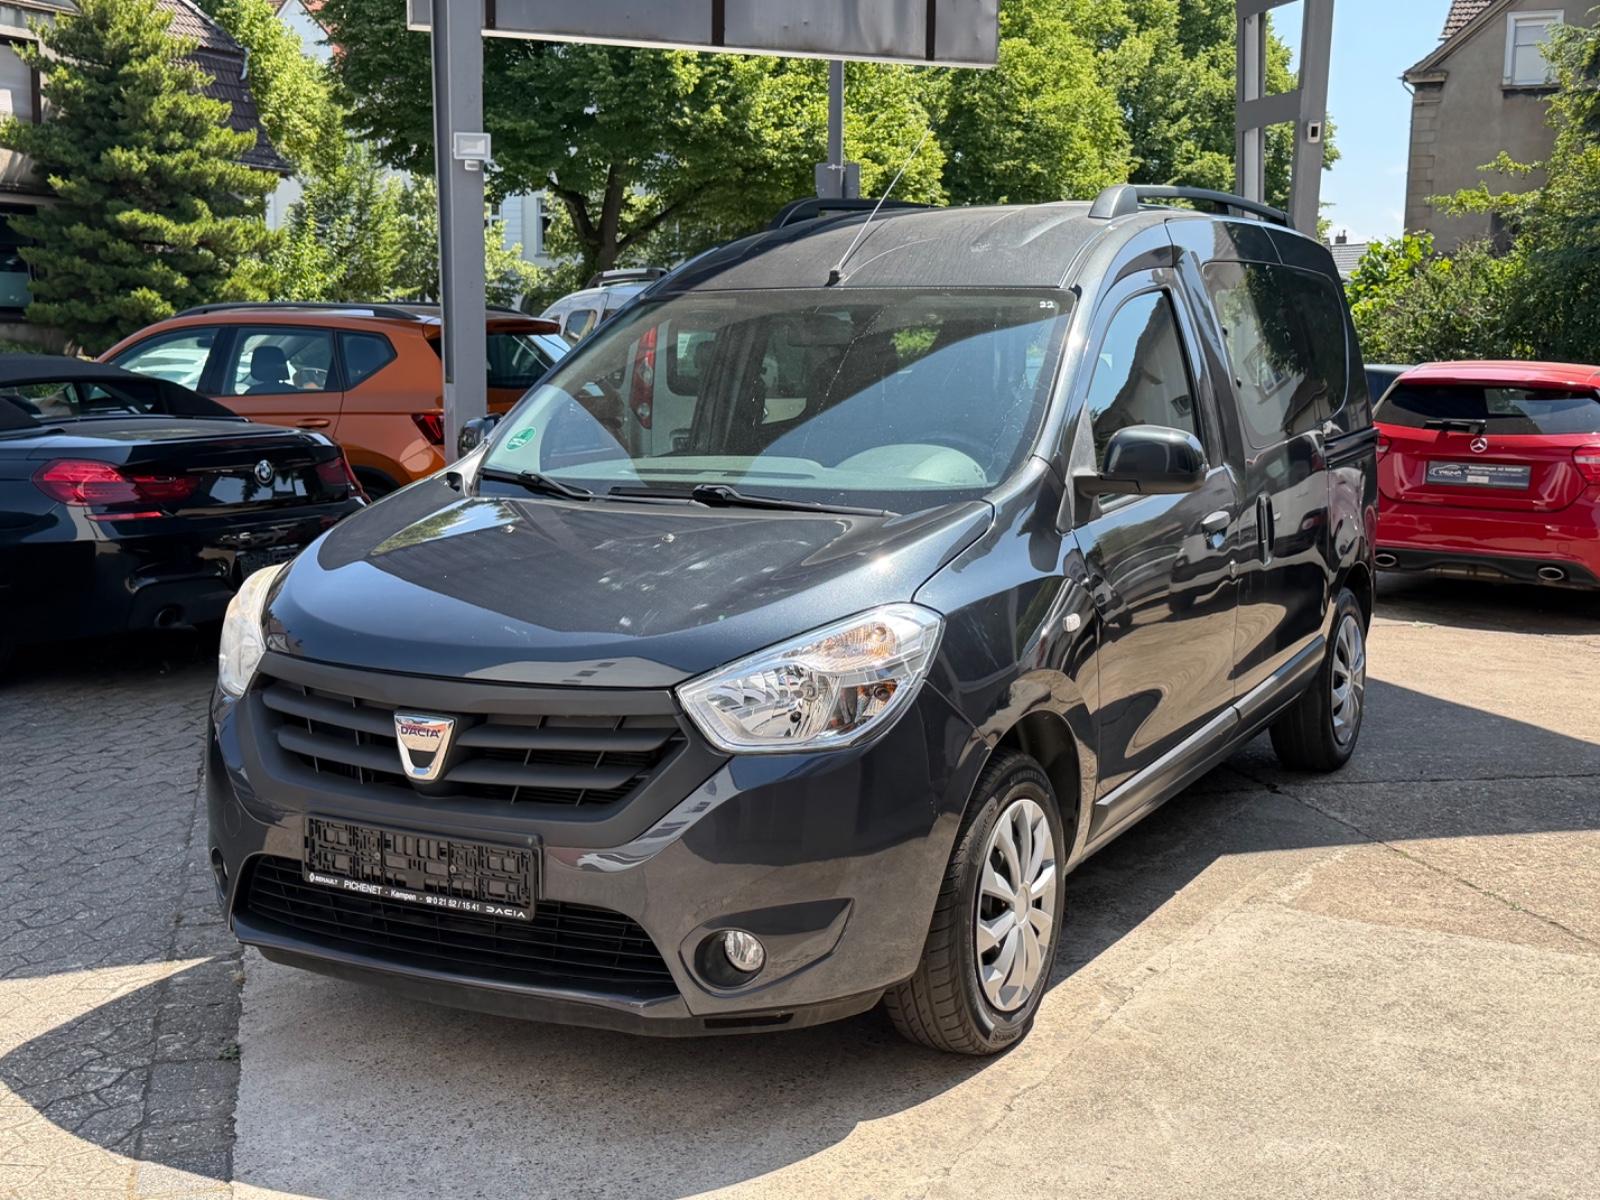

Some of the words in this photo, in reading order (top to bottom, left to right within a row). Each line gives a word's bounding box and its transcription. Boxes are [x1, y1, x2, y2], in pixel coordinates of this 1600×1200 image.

[400, 726, 440, 738] DACIA
[344, 880, 382, 894] PICHENET
[485, 905, 527, 919] DACIA
